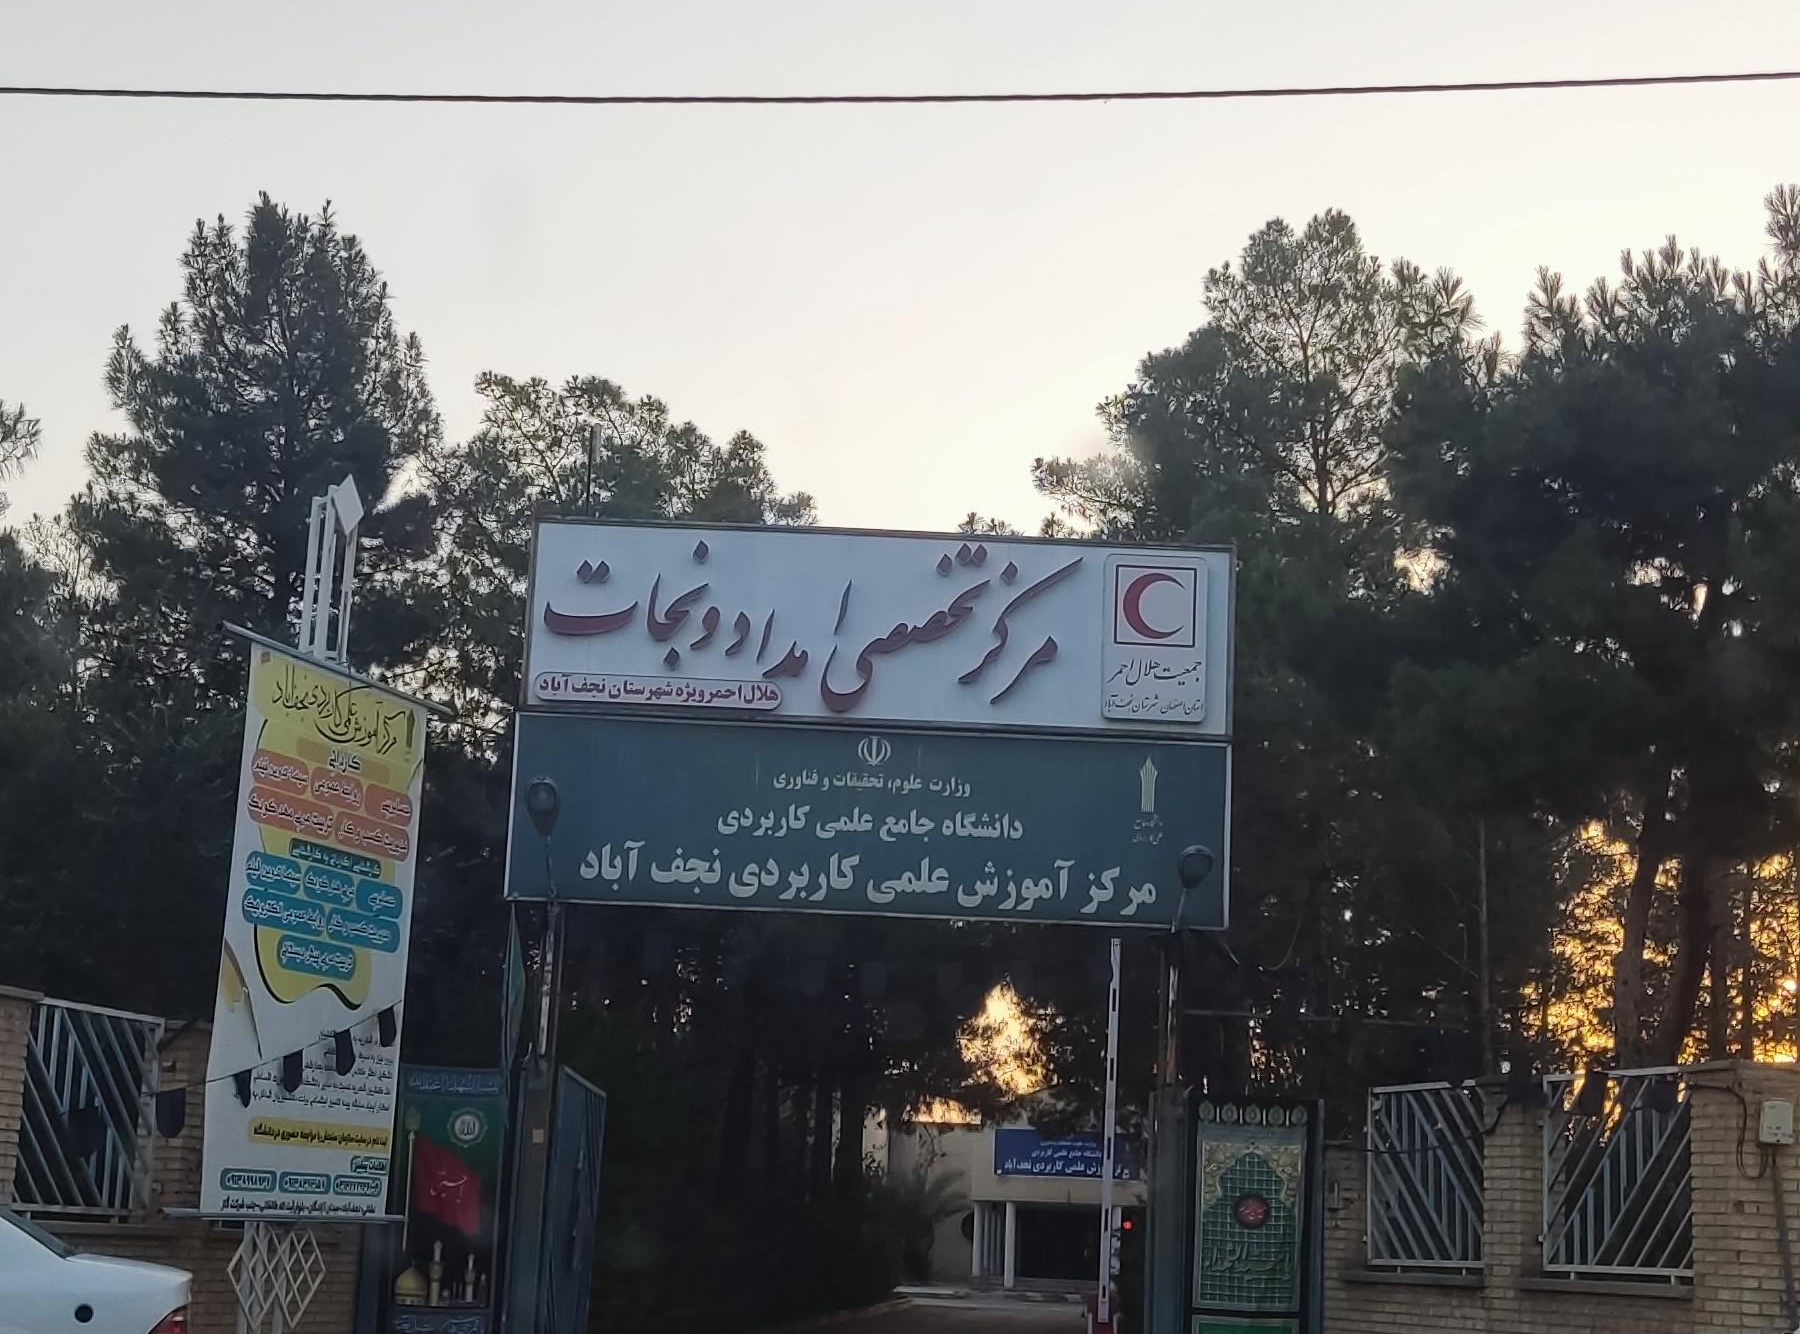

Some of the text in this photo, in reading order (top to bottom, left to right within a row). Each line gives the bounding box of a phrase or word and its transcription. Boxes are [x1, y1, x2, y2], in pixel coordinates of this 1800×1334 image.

[543, 539, 1085, 713] مرکز تخصصی امداد و نجات
[539, 674, 779, 705] هلال احمر ویژه شهرستان نجف آباد
[1106, 658, 1202, 686] جمعیت هلال احمر
[773, 769, 971, 798] وزارت علوم، تحقیقات و فناوری
[717, 803, 1023, 842] دانشگاه جامع علمی کاربردی
[579, 840, 1157, 916] مرکز آموزش علمی کاربردی نجف آباد
